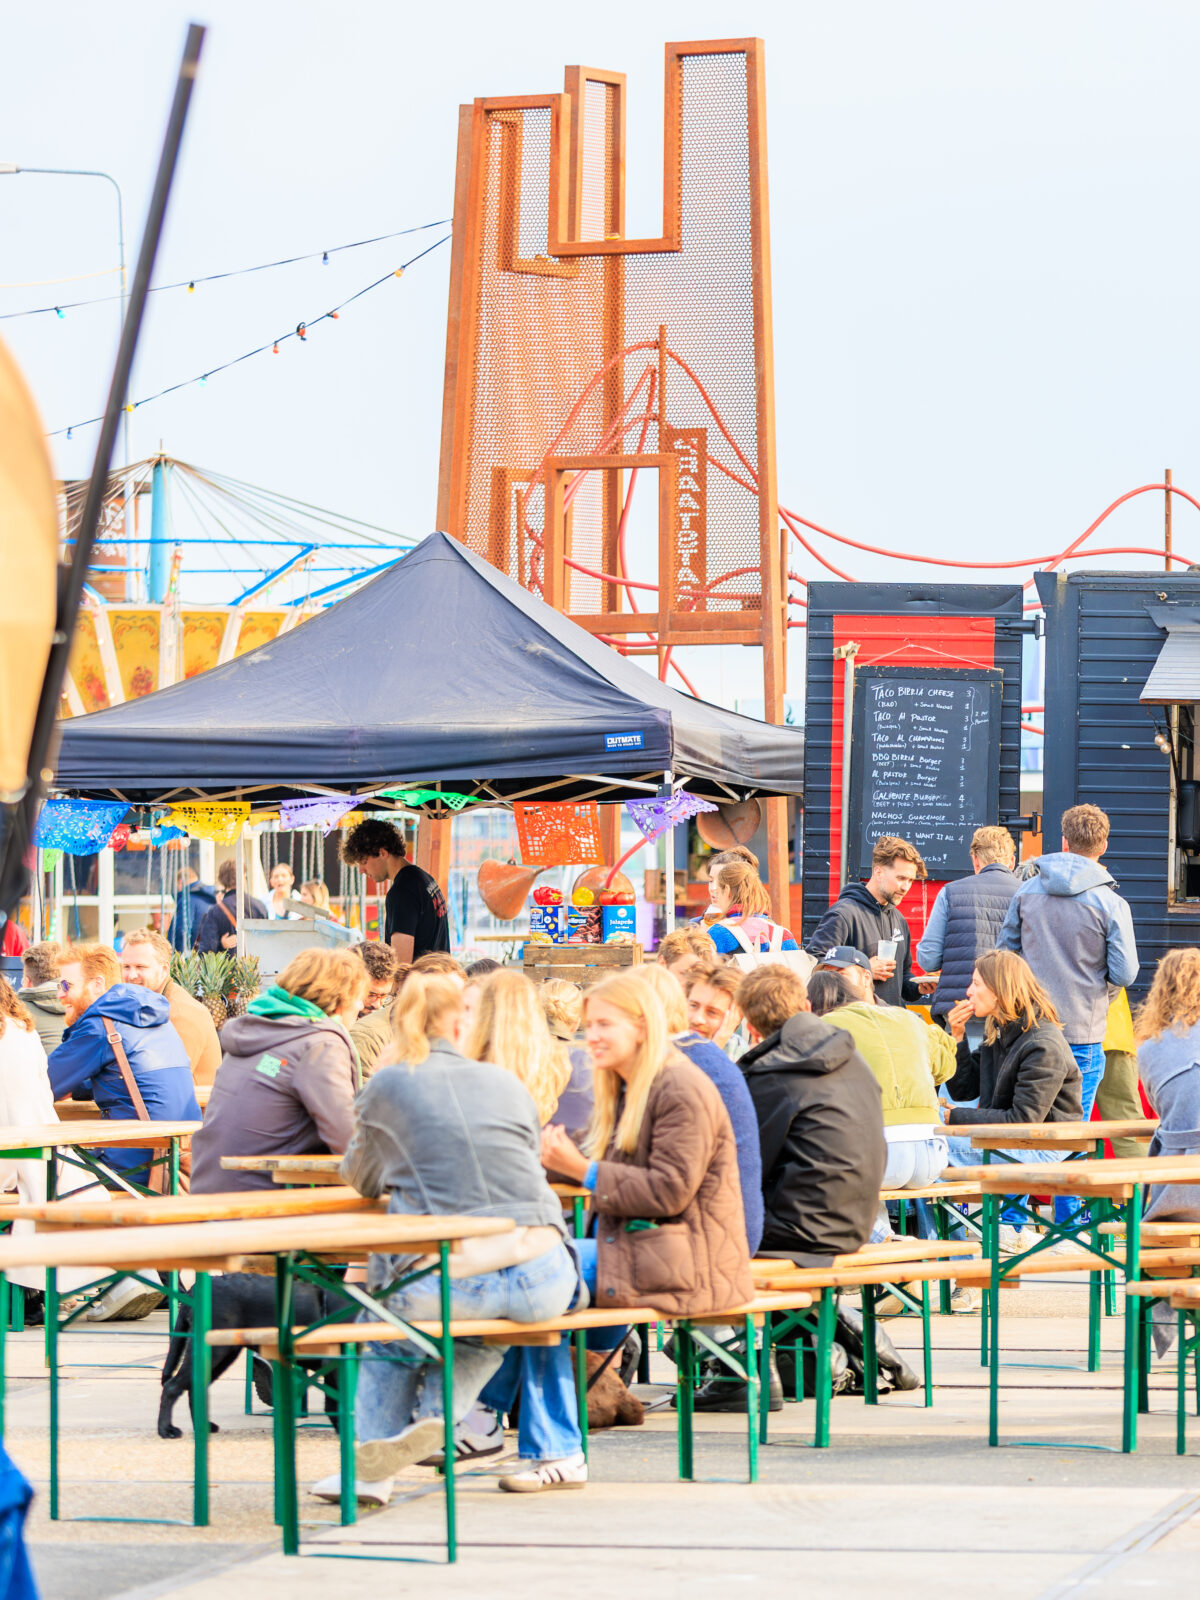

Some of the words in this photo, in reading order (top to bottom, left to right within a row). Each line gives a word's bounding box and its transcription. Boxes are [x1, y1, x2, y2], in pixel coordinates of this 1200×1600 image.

[871, 685, 894, 700] TACO
[927, 689, 955, 698] CHEESE
[873, 711, 891, 722] TACO
[606, 735, 641, 744] OUTMATE
[871, 732, 890, 743] TACO
[871, 752, 890, 762] BBQ
[871, 811, 903, 820] NACHOS
[915, 831, 934, 841] WANT
